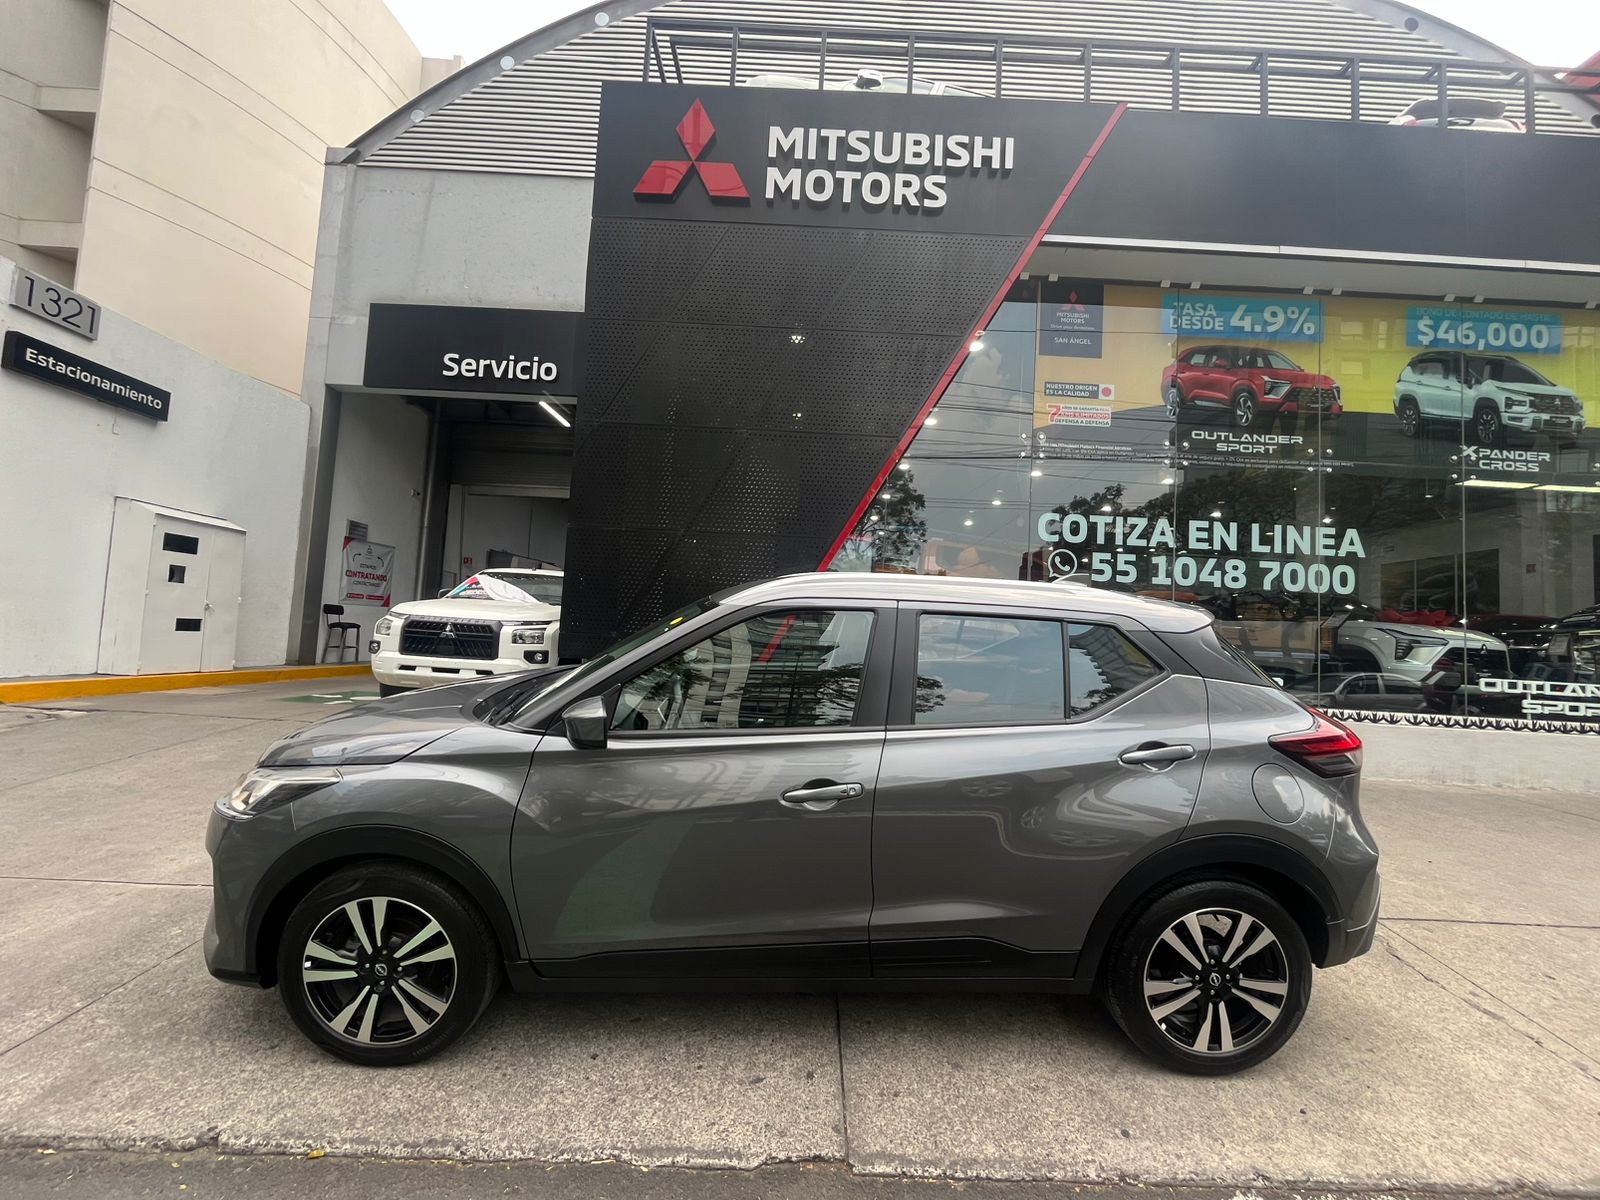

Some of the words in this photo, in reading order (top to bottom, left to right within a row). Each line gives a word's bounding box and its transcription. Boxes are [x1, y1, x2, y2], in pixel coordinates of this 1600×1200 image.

[767, 125, 1015, 170] MITSUBISHI
[765, 166, 948, 208] MOTORS
[25, 275, 97, 334] 1321
[1171, 302, 1217, 317] TASA
[1230, 304, 1316, 335] 4.9%
[1169, 315, 1224, 331] DESDE
[1417, 315, 1550, 351] $46,000
[25, 347, 162, 410] Estacionamiento
[442, 353, 557, 381] Servicio
[1047, 404, 1061, 424] 7
[1191, 430, 1304, 445] OUTLANDER
[1216, 442, 1278, 454] SPORT
[1459, 445, 1551, 462] XPANDER
[1478, 460, 1540, 473] CROSS
[1037, 512, 1176, 548] COTIZA
[1188, 520, 1238, 551] EN
[1251, 523, 1366, 558] LINEA
[345, 569, 388, 582] CONTRATANDO
[1091, 552, 1138, 583] 55
[1151, 555, 1247, 589] 1048
[1258, 561, 1355, 595] 7000
